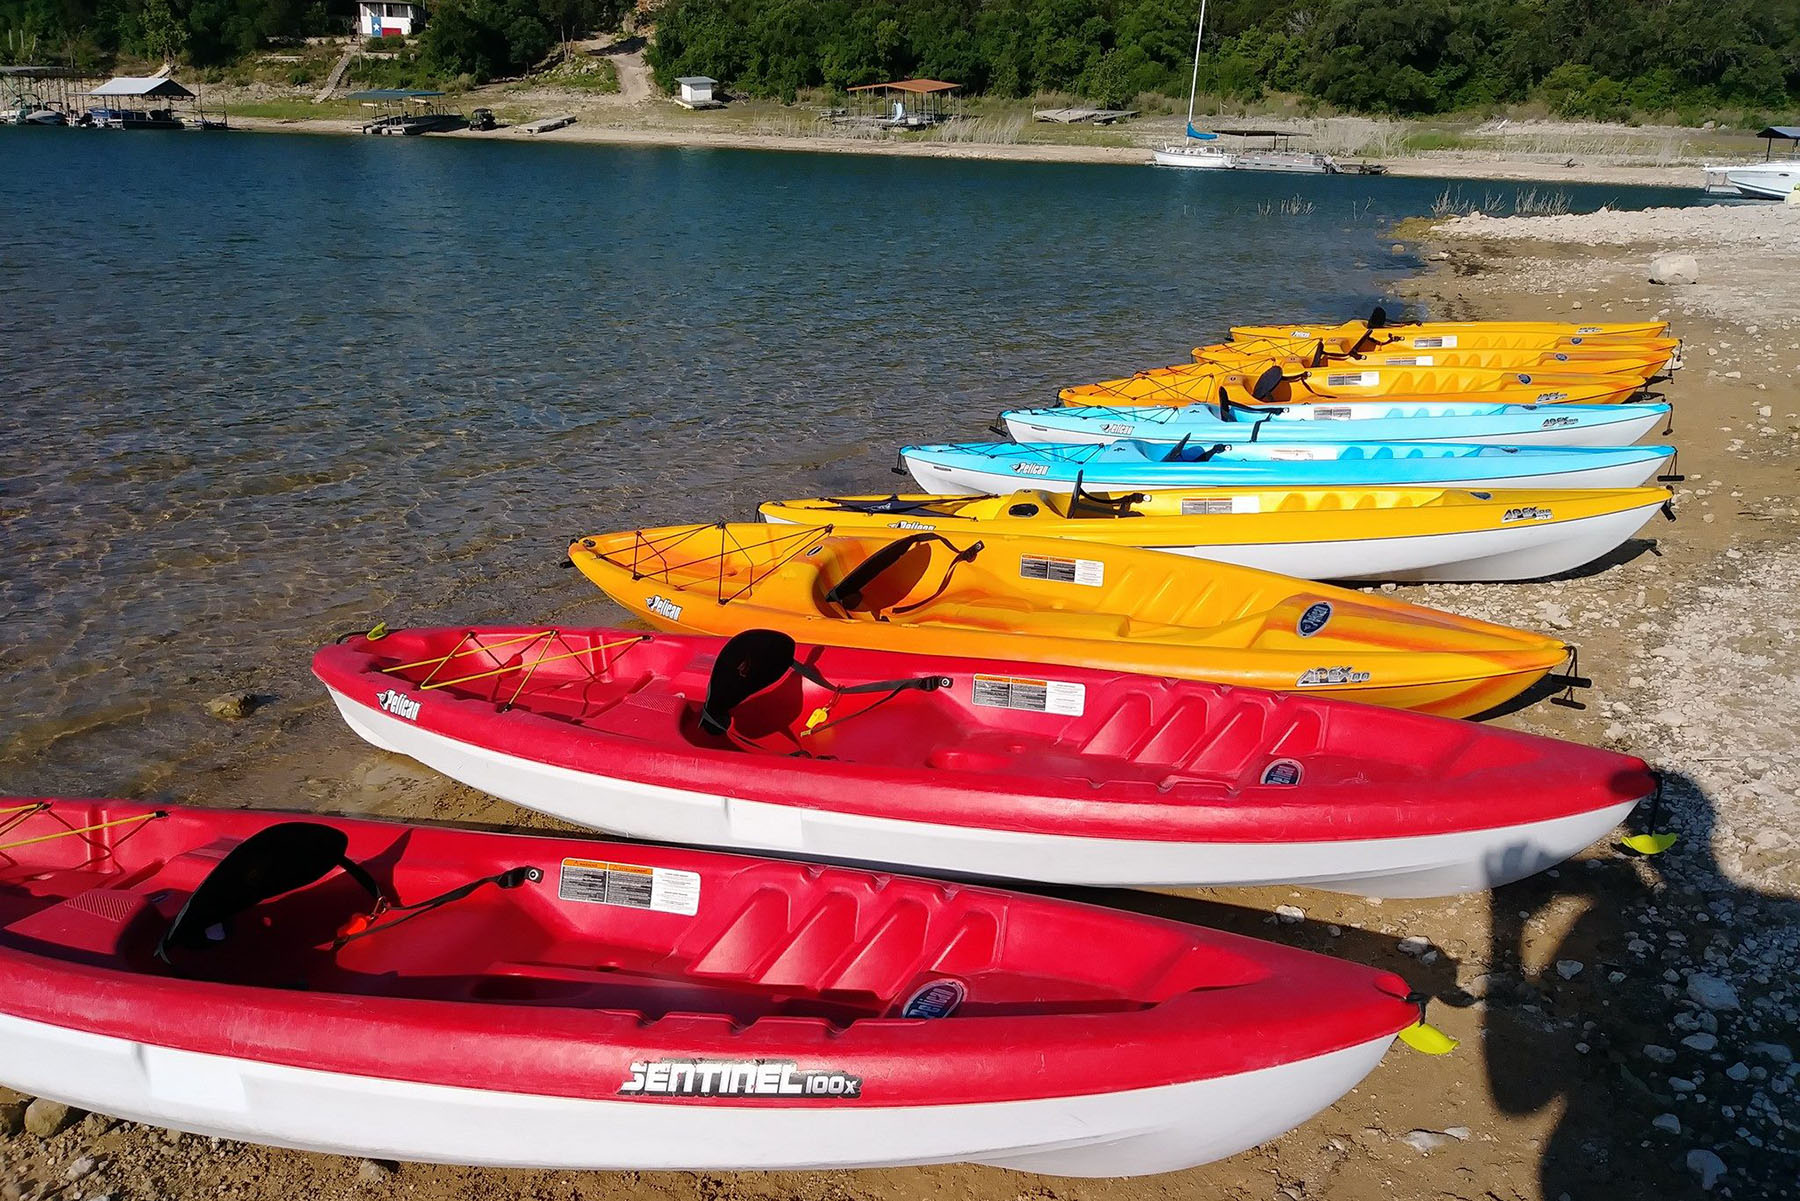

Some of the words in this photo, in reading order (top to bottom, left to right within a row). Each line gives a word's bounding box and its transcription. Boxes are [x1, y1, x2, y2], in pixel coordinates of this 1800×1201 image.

[1016, 462, 1050, 476] Pelican
[650, 595, 683, 621] Pelican
[1298, 665, 1353, 685] APEX
[382, 688, 423, 721] Pelican
[618, 1060, 803, 1096] SENTINEL
